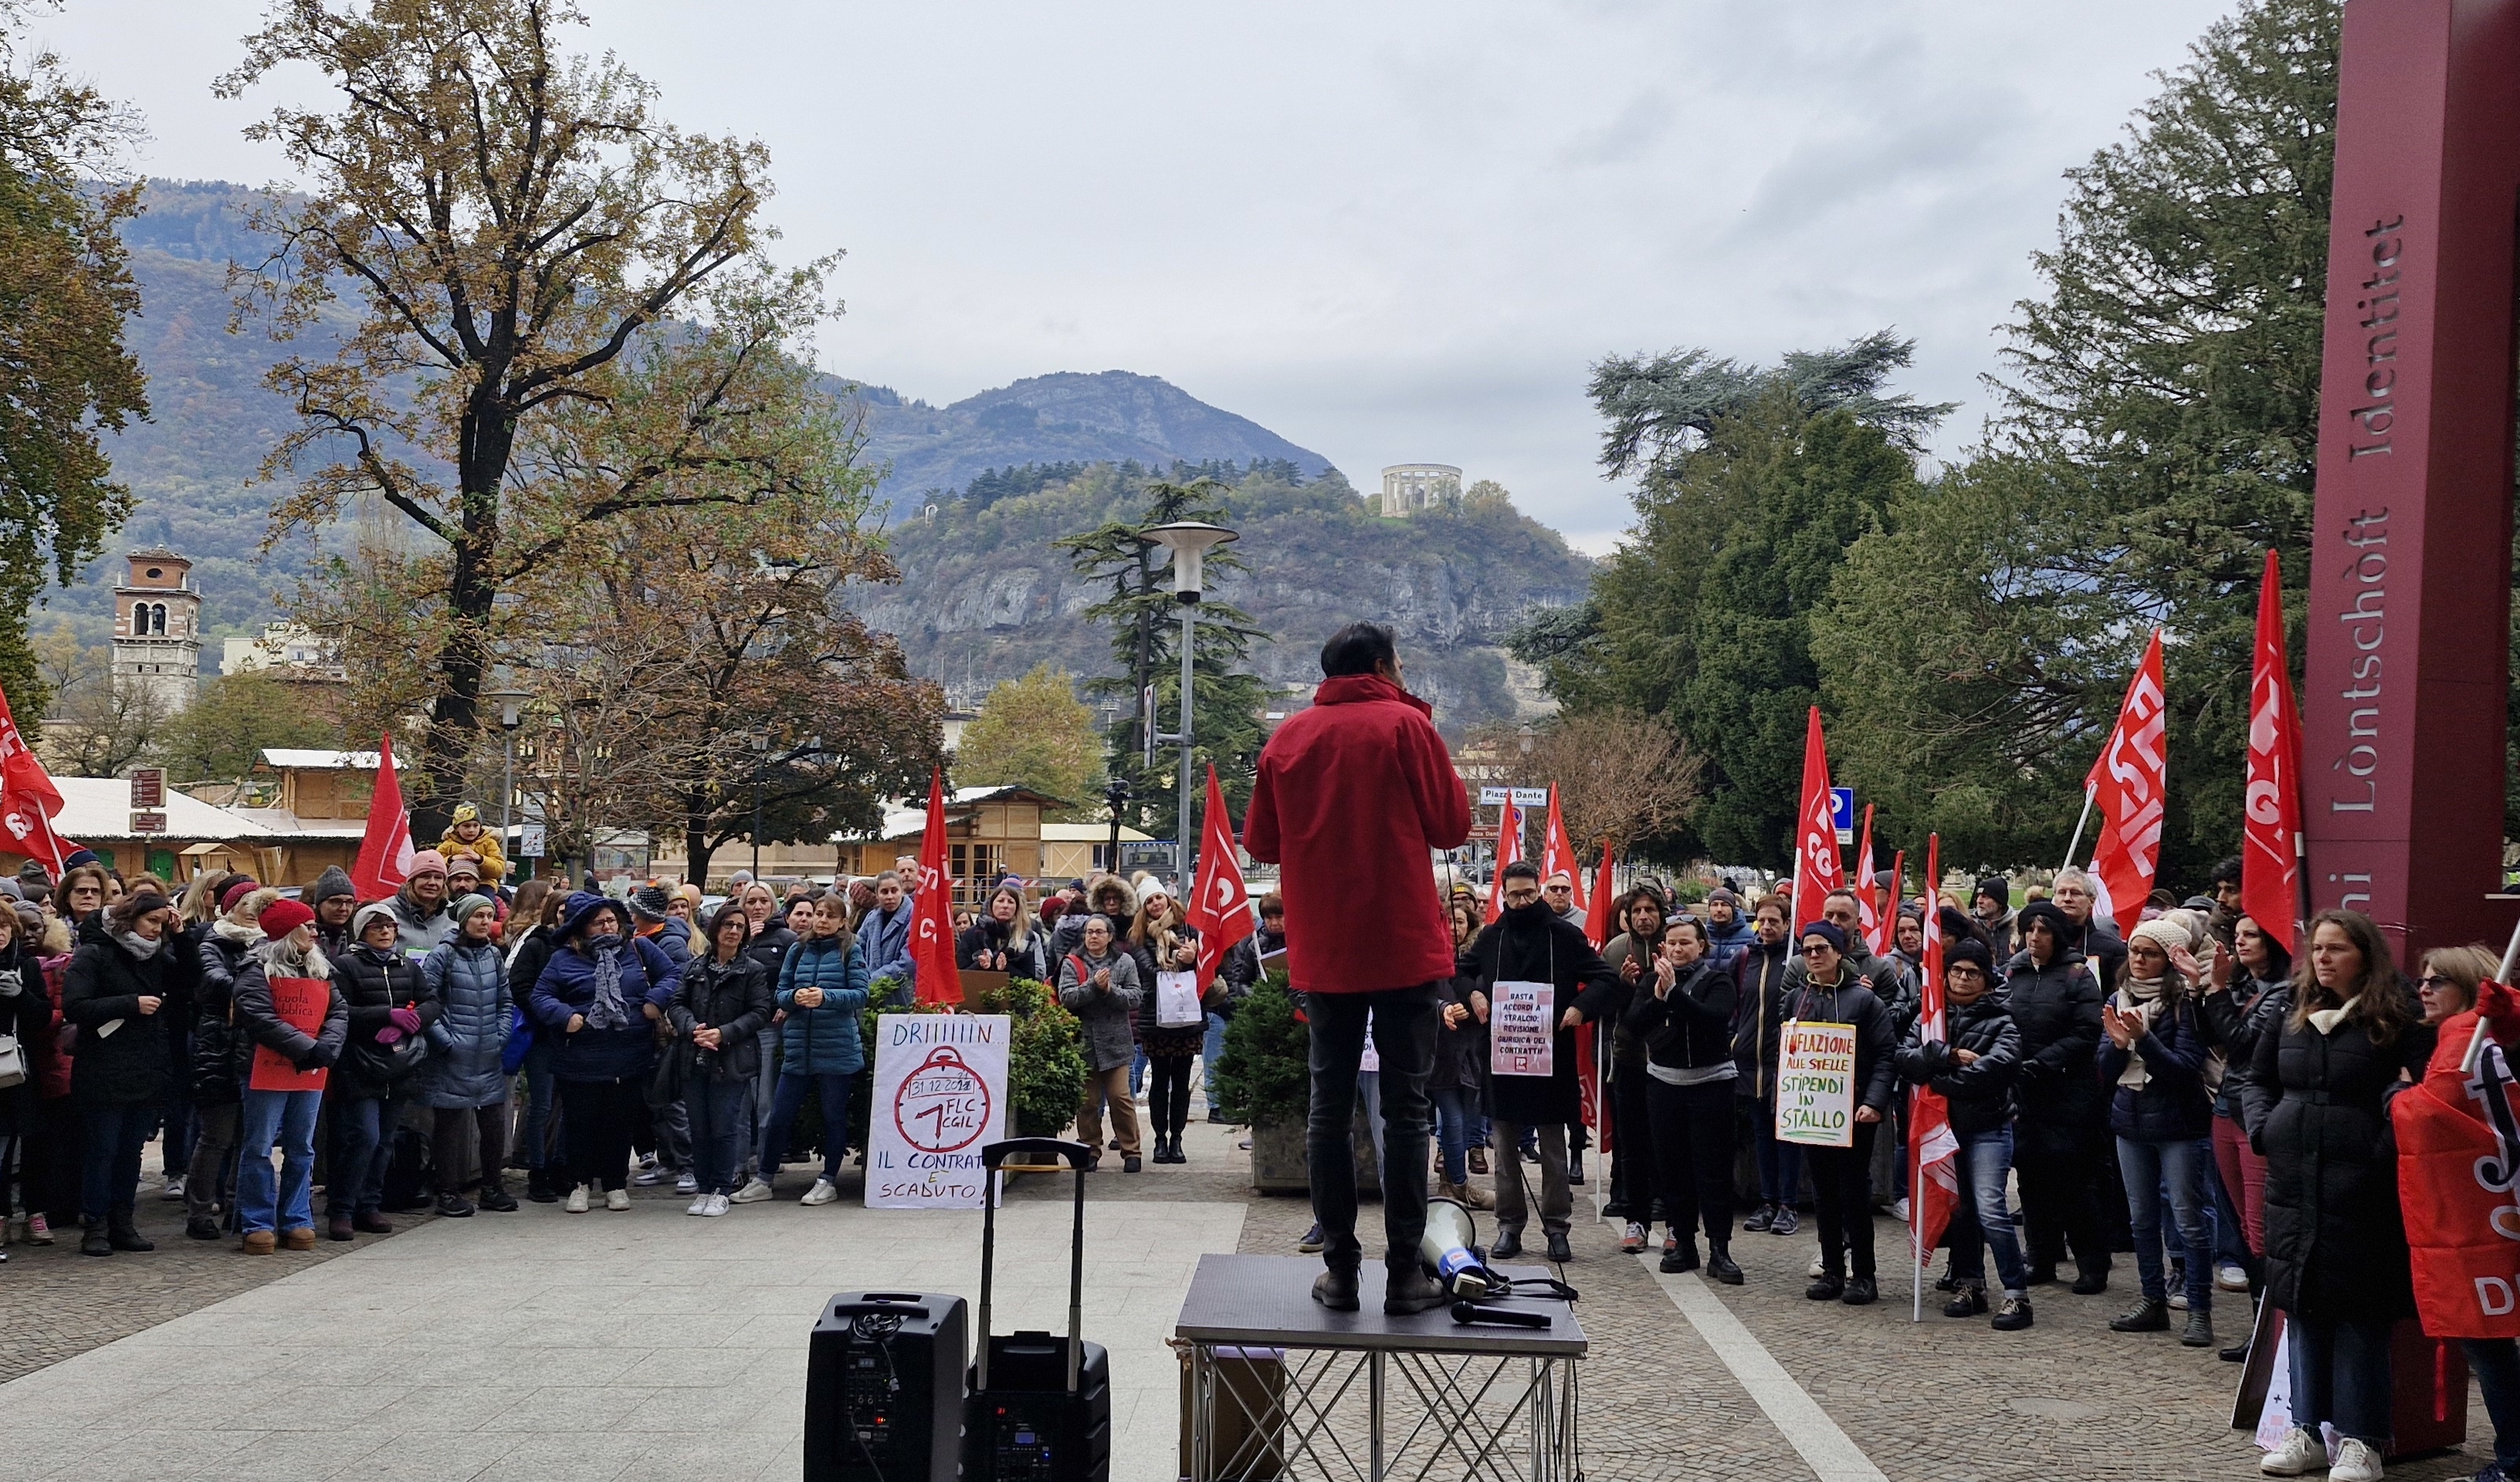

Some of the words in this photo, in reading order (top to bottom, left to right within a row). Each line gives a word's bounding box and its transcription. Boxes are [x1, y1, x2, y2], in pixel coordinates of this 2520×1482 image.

[2350, 213, 2404, 463] Identitet
[2332, 506, 2390, 816] Lòntschòft
[1516, 791, 1543, 799] Dante
[2328, 871, 2372, 921] ni
[275, 1002, 313, 1016] ubblica
[1503, 1013, 1540, 1022] STRALCIO:
[1497, 1036, 1531, 1044] GIURIDICA
[1786, 1057, 1807, 1069] ALLE
[1809, 1058, 1850, 1072] STELLE
[911, 1080, 925, 1095] 31
[929, 1080, 941, 1092] 12
[947, 1099, 976, 1114] FLC
[942, 1115, 974, 1128] CGIL
[1781, 1107, 1846, 1128] STALLO
[878, 1150, 895, 1169] IL
[907, 1152, 983, 1169] CONTRAT
